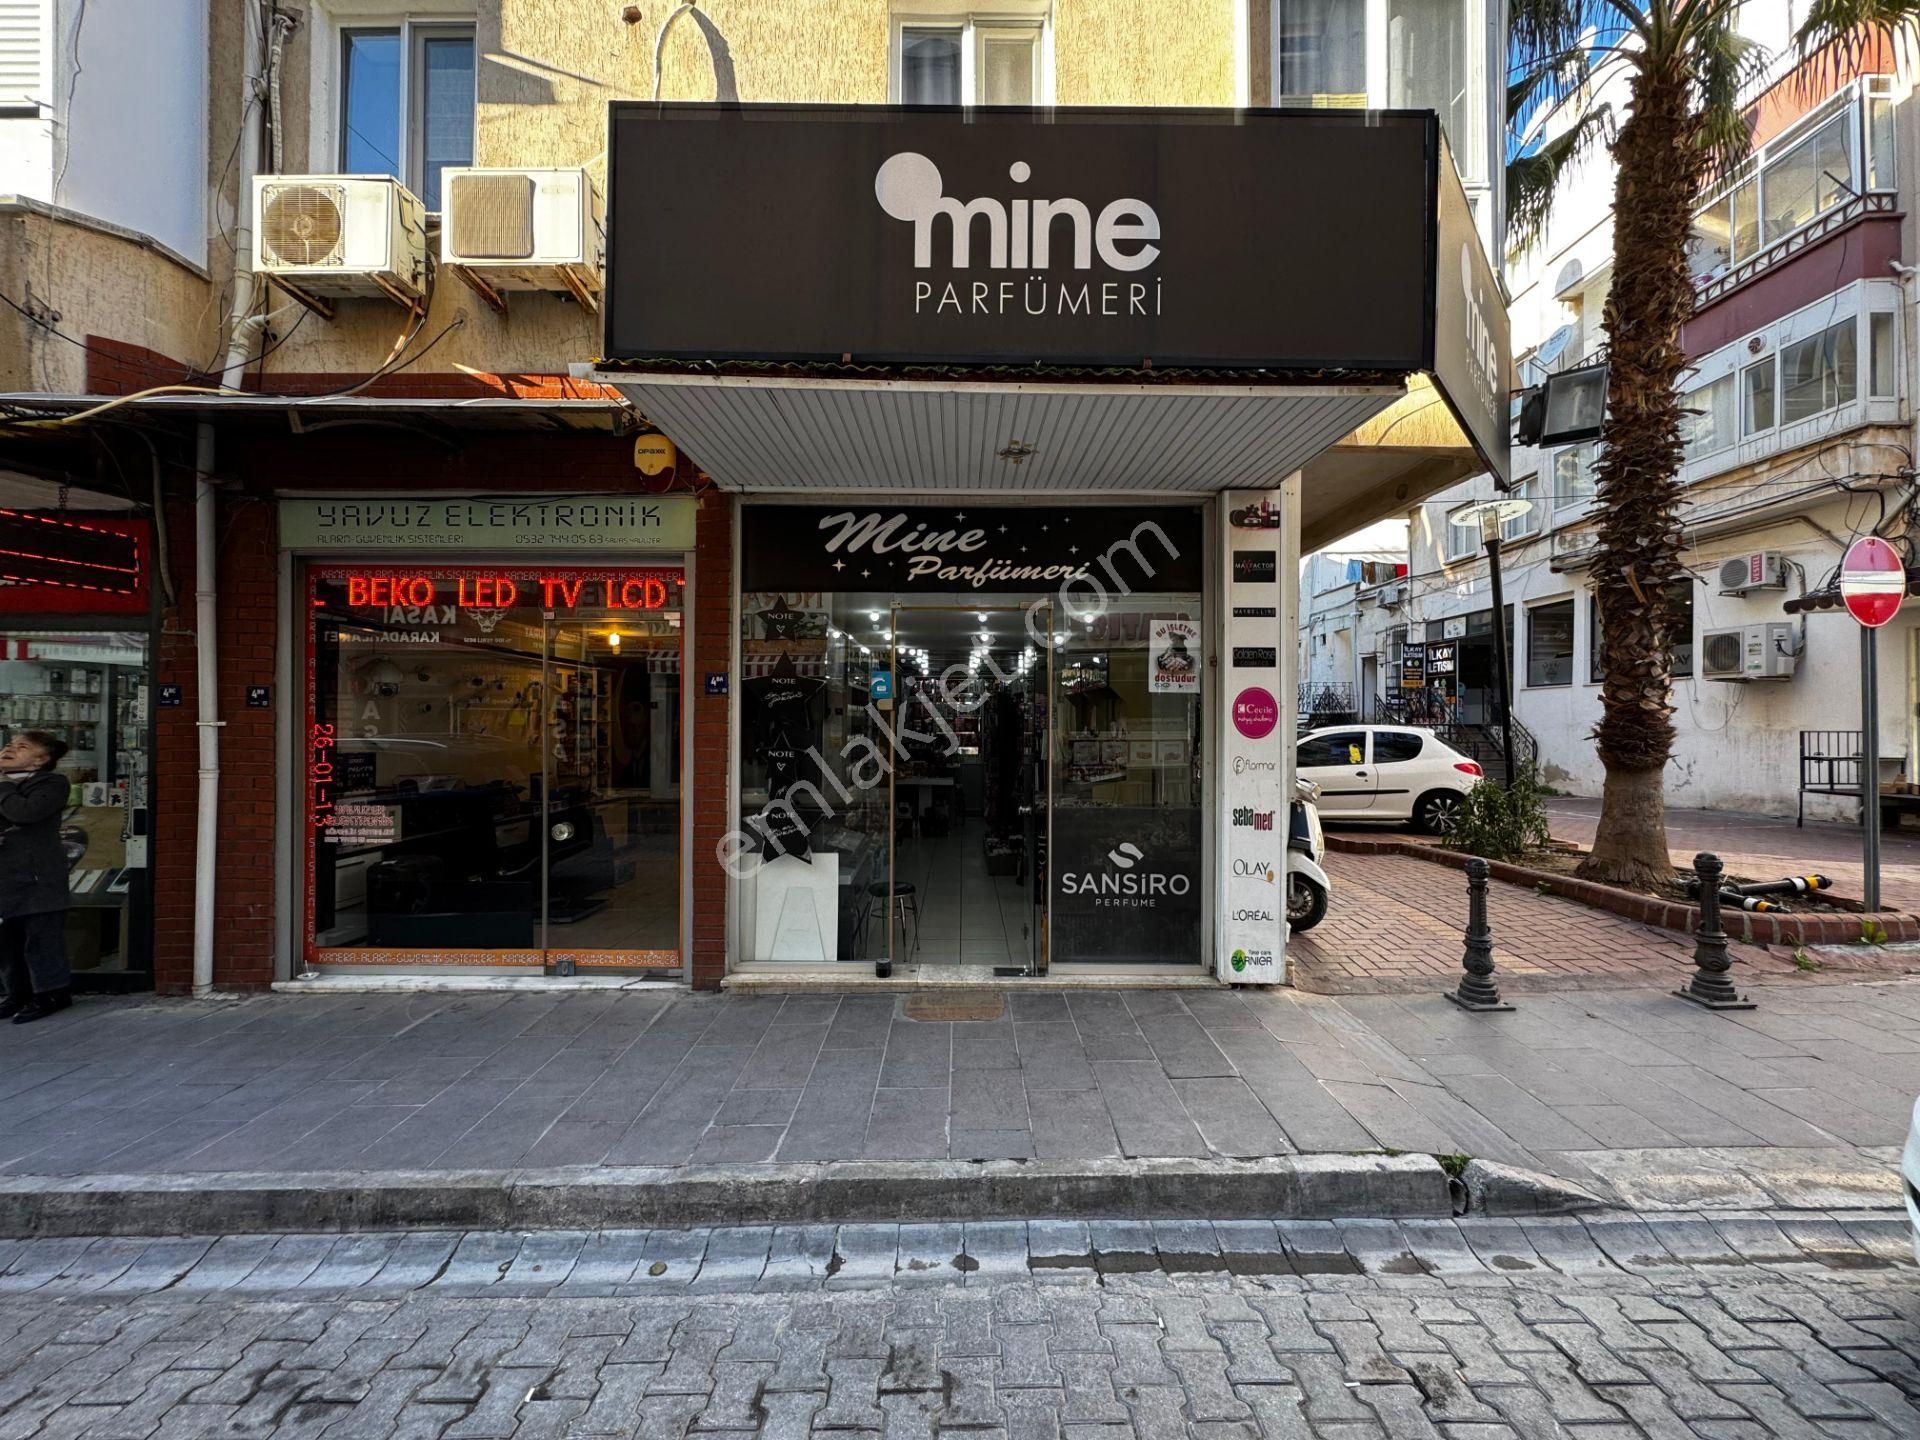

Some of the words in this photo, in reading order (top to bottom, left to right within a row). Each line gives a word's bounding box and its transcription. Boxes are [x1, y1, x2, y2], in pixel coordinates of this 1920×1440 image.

[913, 160, 1161, 272] mine
[914, 275, 1163, 316] PARFÜMERİ
[1465, 287, 1498, 395] mine
[317, 505, 431, 527] YAVUZ
[446, 502, 661, 527] ELEKTRONİK
[515, 534, 545, 544] 0532
[548, 534, 569, 544] 744
[817, 511, 989, 555] Mine
[907, 554, 1091, 588] Parfümeri
[348, 577, 435, 608] BEKO
[458, 577, 518, 608] LED
[539, 577, 584, 608] TV
[606, 577, 667, 609] LCD
[767, 611, 795, 620] NOTE
[771, 677, 797, 685] NOTE
[1155, 673, 1196, 683] dostudur
[768, 750, 795, 758] NOTE
[1232, 806, 1273, 831] sebamed
[1232, 858, 1270, 876] OLAY
[1095, 898, 1156, 907] PERFUME
